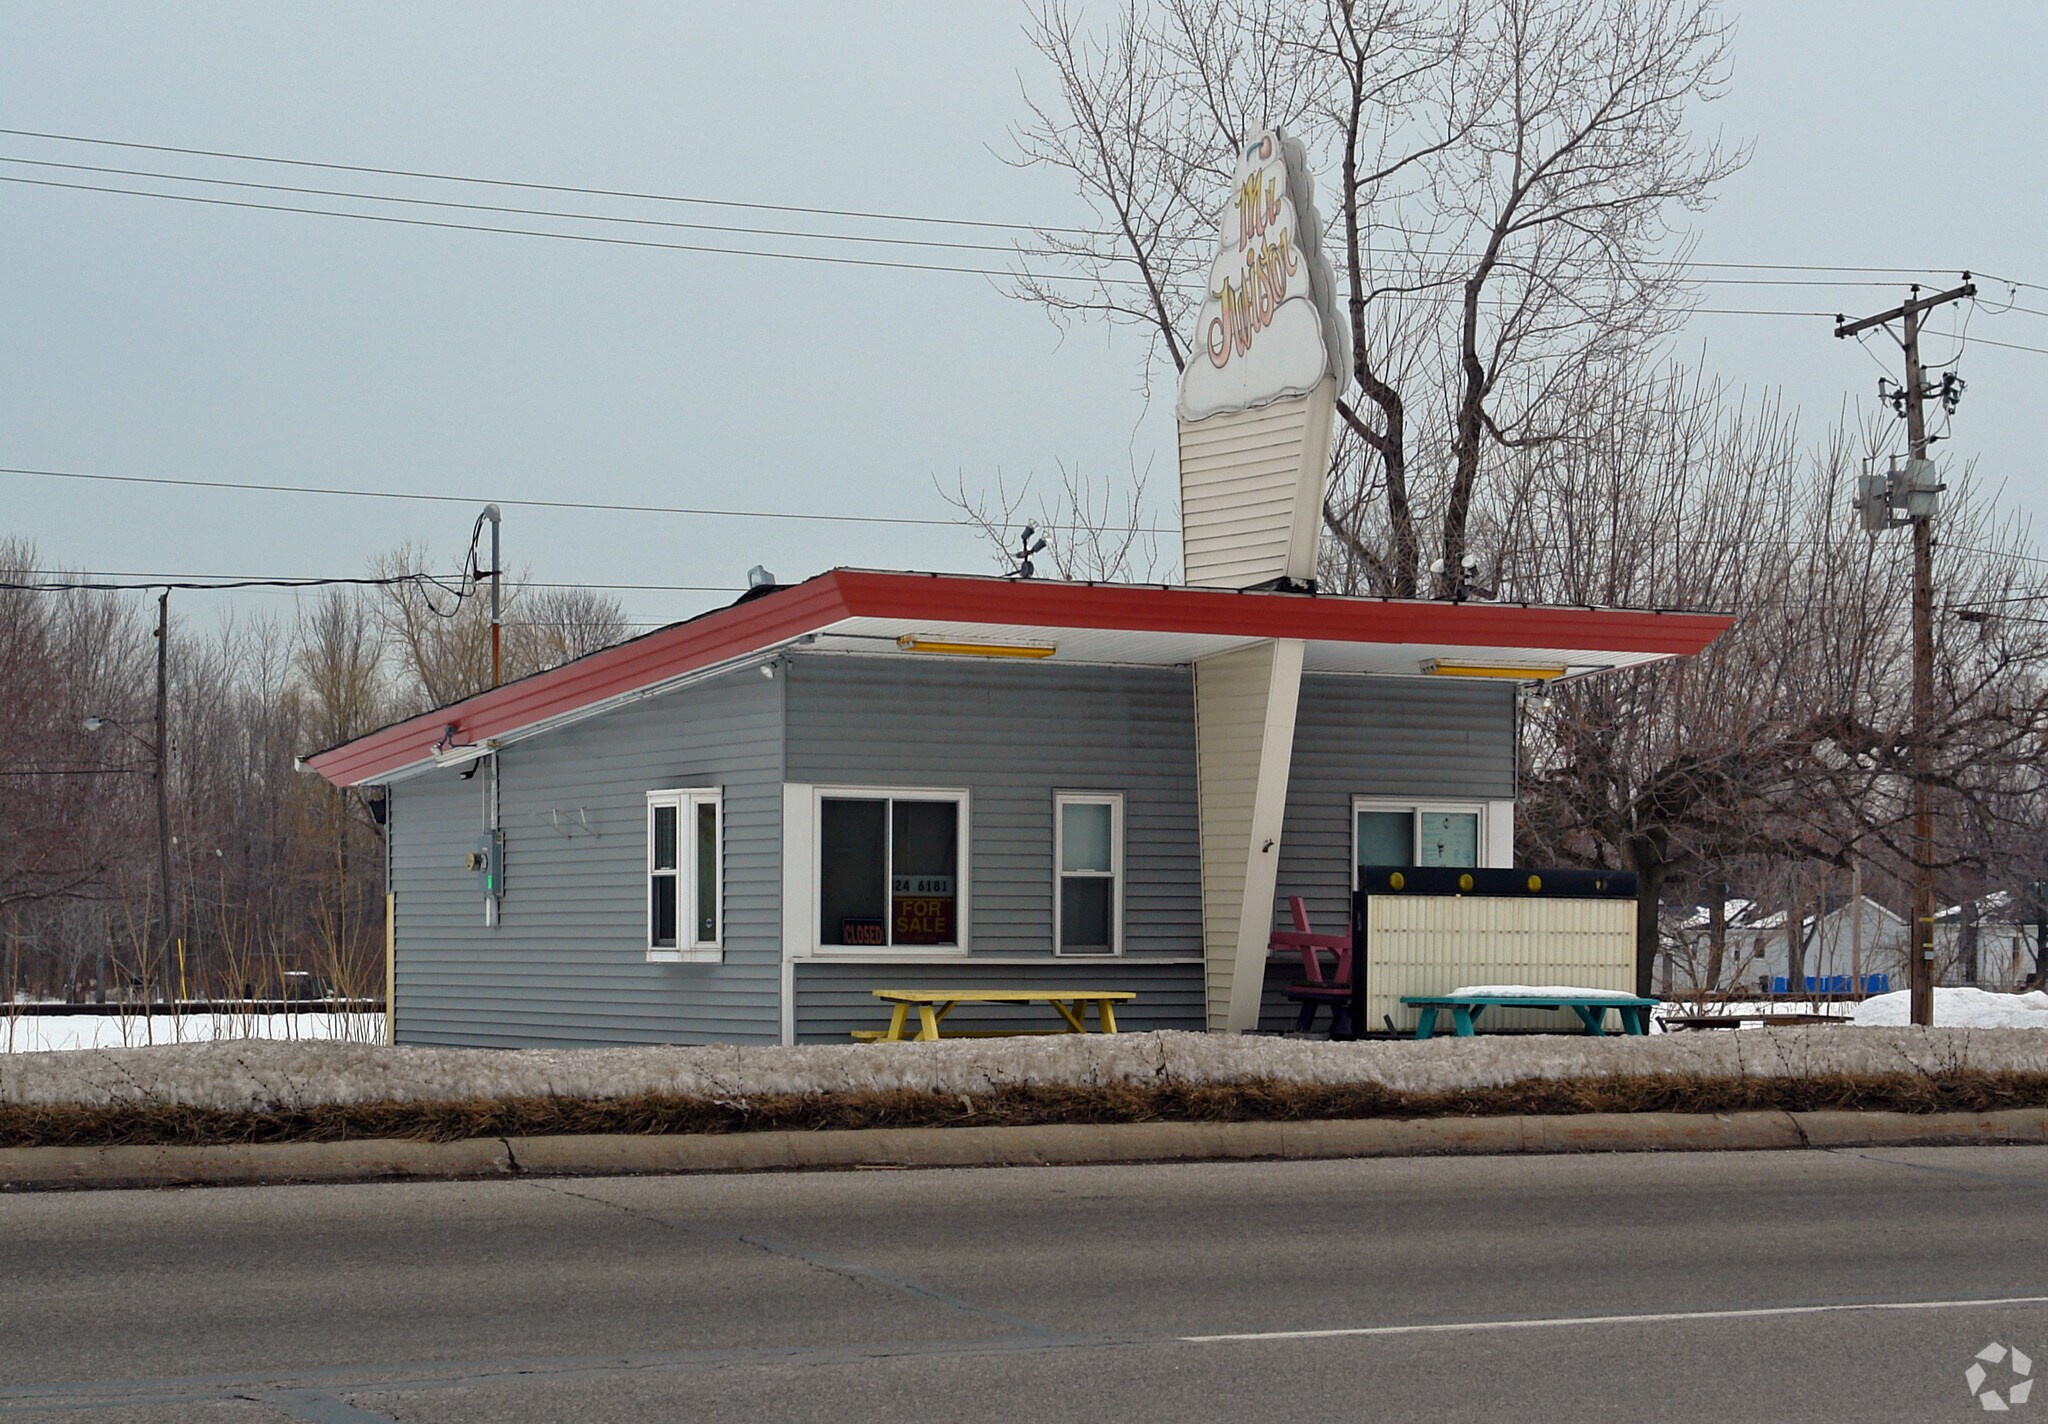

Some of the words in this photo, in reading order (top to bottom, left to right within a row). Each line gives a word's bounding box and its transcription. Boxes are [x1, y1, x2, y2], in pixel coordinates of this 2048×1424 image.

[1235, 167, 1281, 252] Mr.
[892, 880, 910, 892] 24
[917, 880, 947, 892] 6181
[902, 901, 941, 916] FOR
[897, 917, 946, 933] SALE
[845, 924, 883, 945] CLOSED
